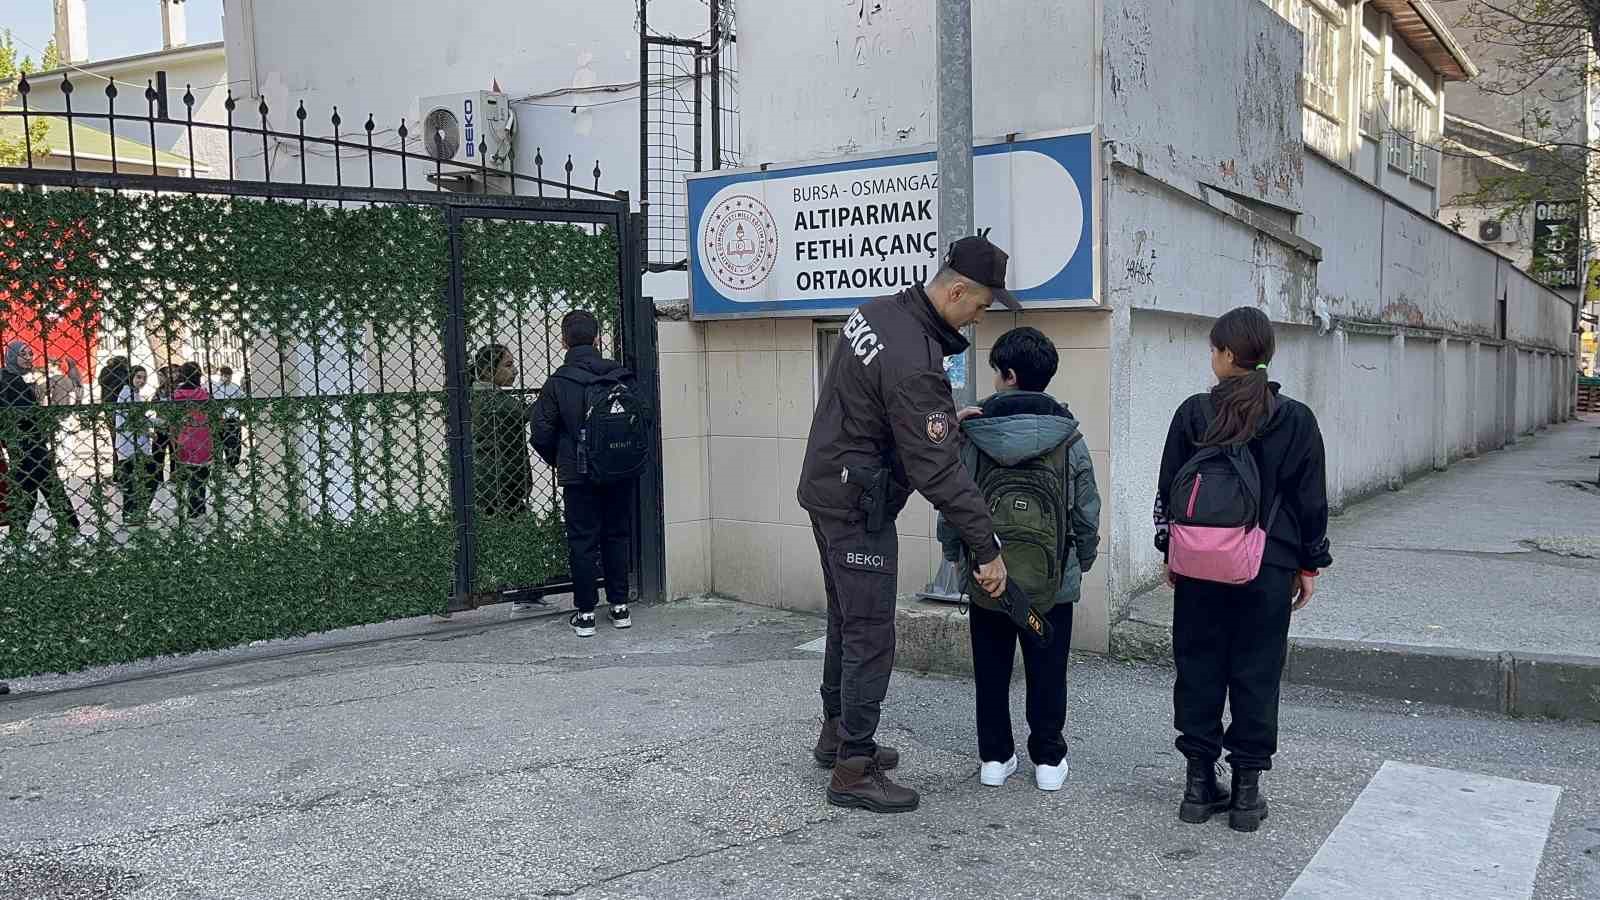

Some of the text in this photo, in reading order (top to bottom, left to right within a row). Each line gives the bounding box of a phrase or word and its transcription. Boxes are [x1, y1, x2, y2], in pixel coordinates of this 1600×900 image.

[463, 99, 475, 158] BEKO
[793, 184, 839, 203] BURSA
[851, 173, 939, 197] OSMANGAZ
[794, 199, 933, 231] ALTIPARMAK
[795, 233, 854, 262] FETHİ
[796, 264, 928, 292] ORTAOKULU
